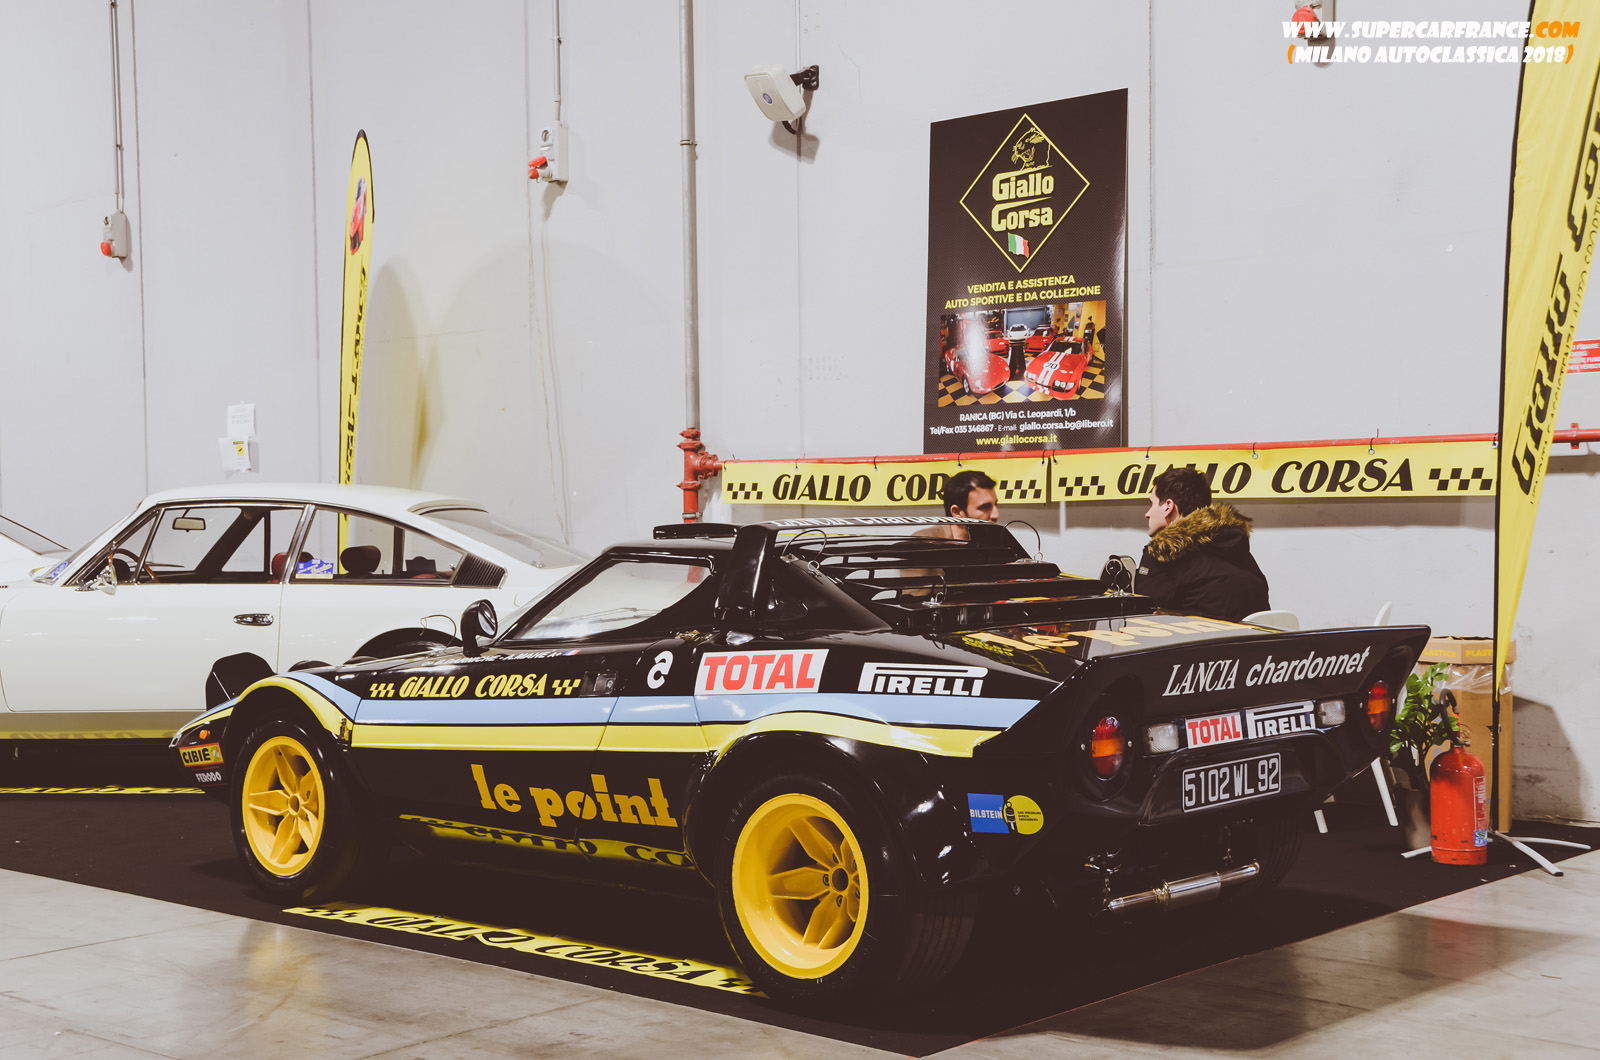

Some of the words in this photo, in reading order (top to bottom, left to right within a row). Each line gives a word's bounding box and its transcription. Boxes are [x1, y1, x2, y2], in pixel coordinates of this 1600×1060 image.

[992, 170, 1055, 201] Giallo
[991, 197, 1053, 232] Corsa
[944, 298, 969, 310] AUTO
[970, 293, 1014, 307] SPORTIVE
[1016, 293, 1022, 302] E
[1024, 291, 1038, 301] DA
[1039, 285, 1101, 300] COLLEZIONE
[967, 281, 1006, 294] VENDITA
[1008, 281, 1014, 290] E
[1015, 275, 1075, 289] ASSISTENZA
[930, 425, 954, 435] Tel/Fax
[954, 425, 967, 434] 035
[967, 424, 994, 433] 346867
[1019, 419, 1114, 433] giallo.corsa.bg@libero.it
[960, 412, 988, 422] RANICA
[988, 410, 1005, 421] (BG)
[1005, 410, 1018, 419] Via
[1018, 410, 1026, 419] G.
[1027, 408, 1063, 421] Leopardi,
[1064, 407, 1076, 418] 1/b
[976, 433, 1058, 446] www.giallocorsa.it
[772, 473, 872, 503] GIALLO
[886, 472, 952, 503] COR
[1270, 458, 1414, 494] CORSA
[1424, 648, 1458, 658] LASTICA
[399, 675, 470, 698] GIALLO
[474, 673, 548, 698] CORSA
[704, 653, 818, 691] TOTAL
[857, 662, 988, 696] PIRELLI
[1162, 659, 1240, 697] LANCIA
[1245, 645, 1371, 687] chardonnet
[1188, 715, 1241, 746] TOTAL
[1245, 700, 1316, 740] PIRELLI
[470, 764, 522, 813] le
[529, 774, 678, 828] point
[1184, 767, 1230, 807] 5102
[1233, 763, 1255, 797] WL
[1258, 757, 1279, 791] 92
